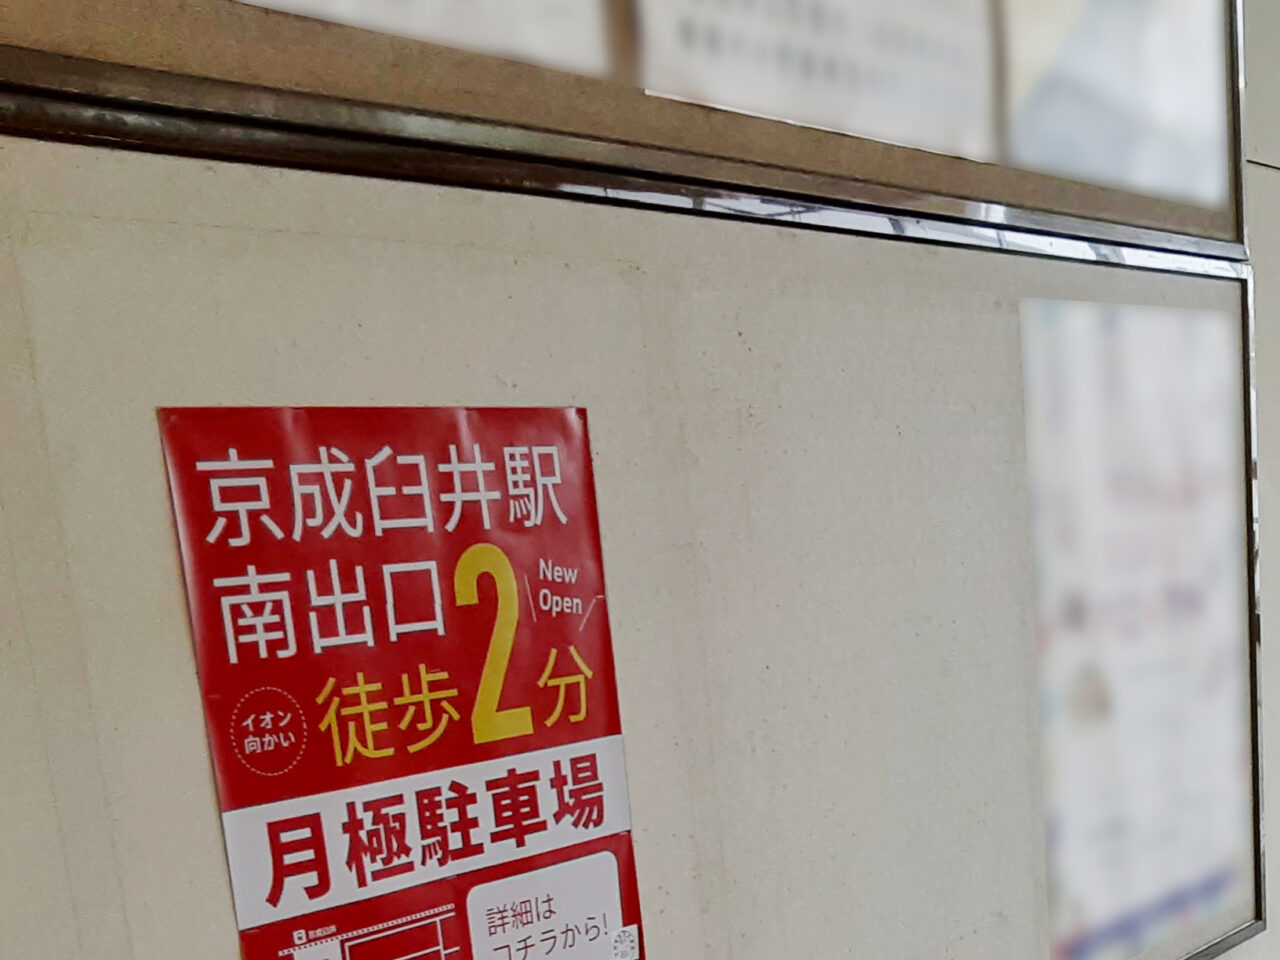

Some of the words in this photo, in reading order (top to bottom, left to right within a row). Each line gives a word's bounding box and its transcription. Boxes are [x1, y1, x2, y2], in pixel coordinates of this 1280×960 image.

[196, 442, 569, 548] 京成臼井駅
[538, 558, 578, 585] New
[212, 559, 446, 664] 南出口
[538, 589, 583, 617] Open
[241, 709, 292, 733] イオン
[244, 731, 296, 755] 向かい
[264, 753, 605, 908] 月極駐車場
[485, 893, 557, 937] 詳細は
